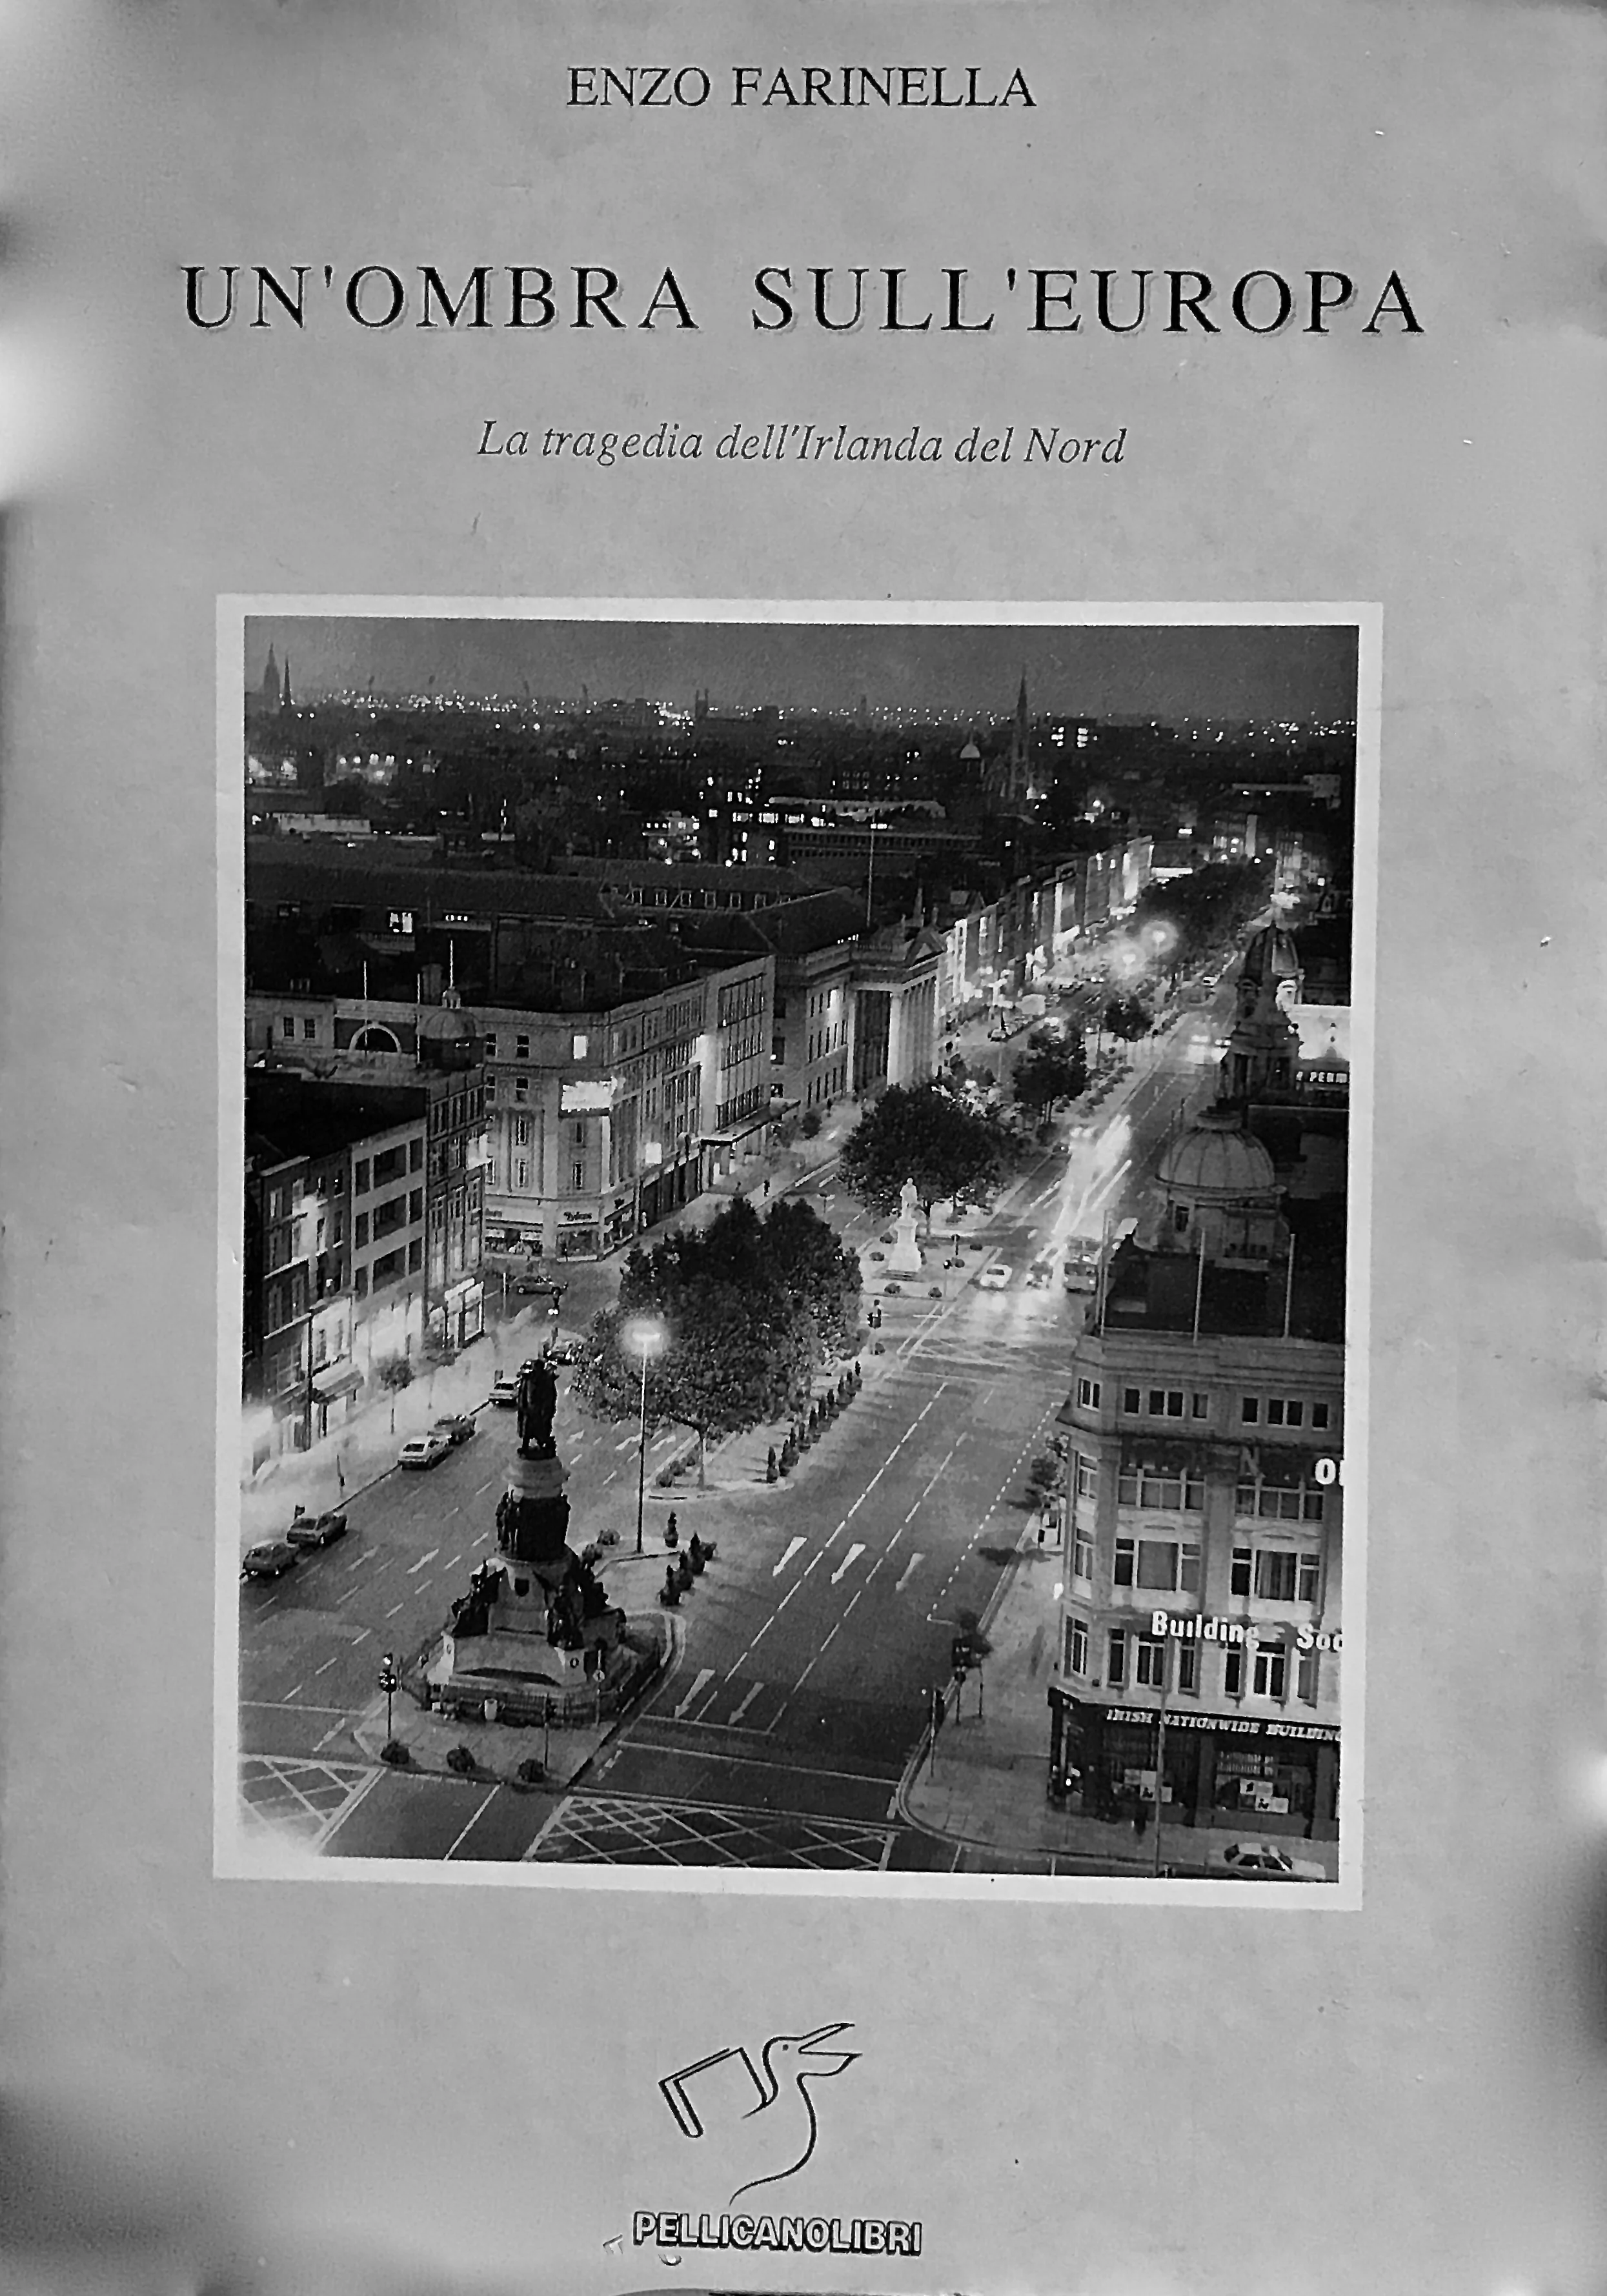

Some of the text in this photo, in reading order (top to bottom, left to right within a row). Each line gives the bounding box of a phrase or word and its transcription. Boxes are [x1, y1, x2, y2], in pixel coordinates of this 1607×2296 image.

[567, 68, 1038, 107] ENZO FARINELLA
[181, 266, 1426, 335] UN'OMBRA SULL'EUROPA
[477, 421, 1128, 467] La tragedia dell'Irlanda del Nord
[1151, 1611, 1260, 1651] Building
[1106, 1708, 1154, 1724] IRISH
[632, 2210, 923, 2257] PELLICANOLIBRI
